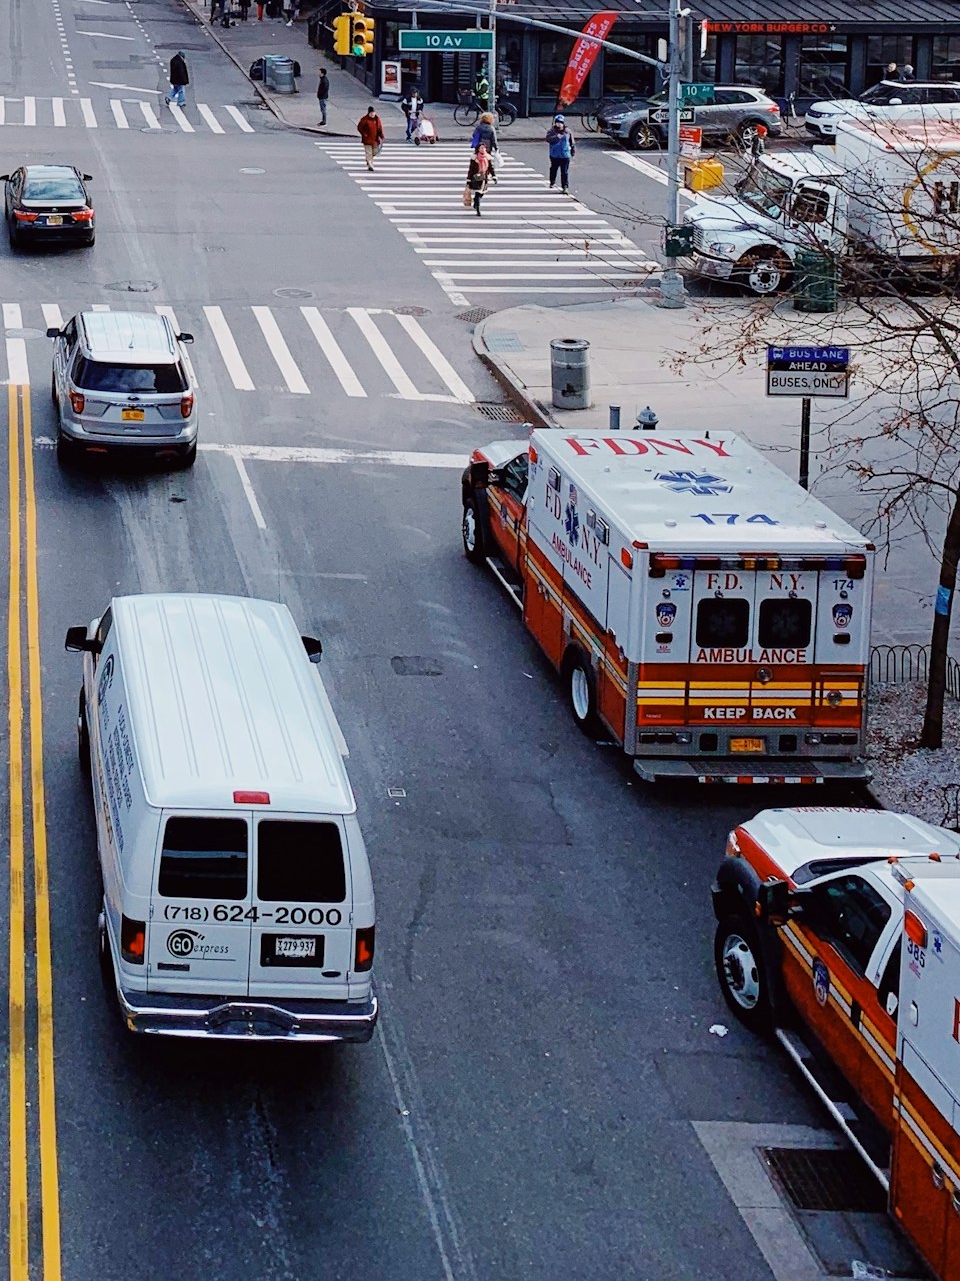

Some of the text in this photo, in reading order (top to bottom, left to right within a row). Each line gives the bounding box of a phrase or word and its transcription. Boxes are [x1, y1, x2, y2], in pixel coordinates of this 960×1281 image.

[707, 23, 732, 32] NEW
[734, 23, 764, 32] YORK
[766, 23, 808, 32] BURGER
[426, 35, 462, 46] 10 Av
[568, 22, 598, 69] Burgrs
[686, 86, 697, 96] 10
[789, 350, 844, 359] BUS LANE
[788, 361, 827, 371] AHEAD
[813, 378, 841, 389] ONLY
[562, 437, 732, 457] FDNY
[690, 513, 780, 526] 174
[552, 532, 592, 590] AMBULANCE
[707, 574, 743, 590] F.D.
[769, 574, 805, 590] N.Y.
[832, 579, 855, 591] 174
[696, 648, 807, 663] AMBULANCE
[704, 707, 797, 719] KEEP BACK
[164, 904, 342, 926] (718) 624-2000
[171, 937, 192, 953] GO
[193, 943, 229, 958] express
[906, 936, 926, 968] 385
